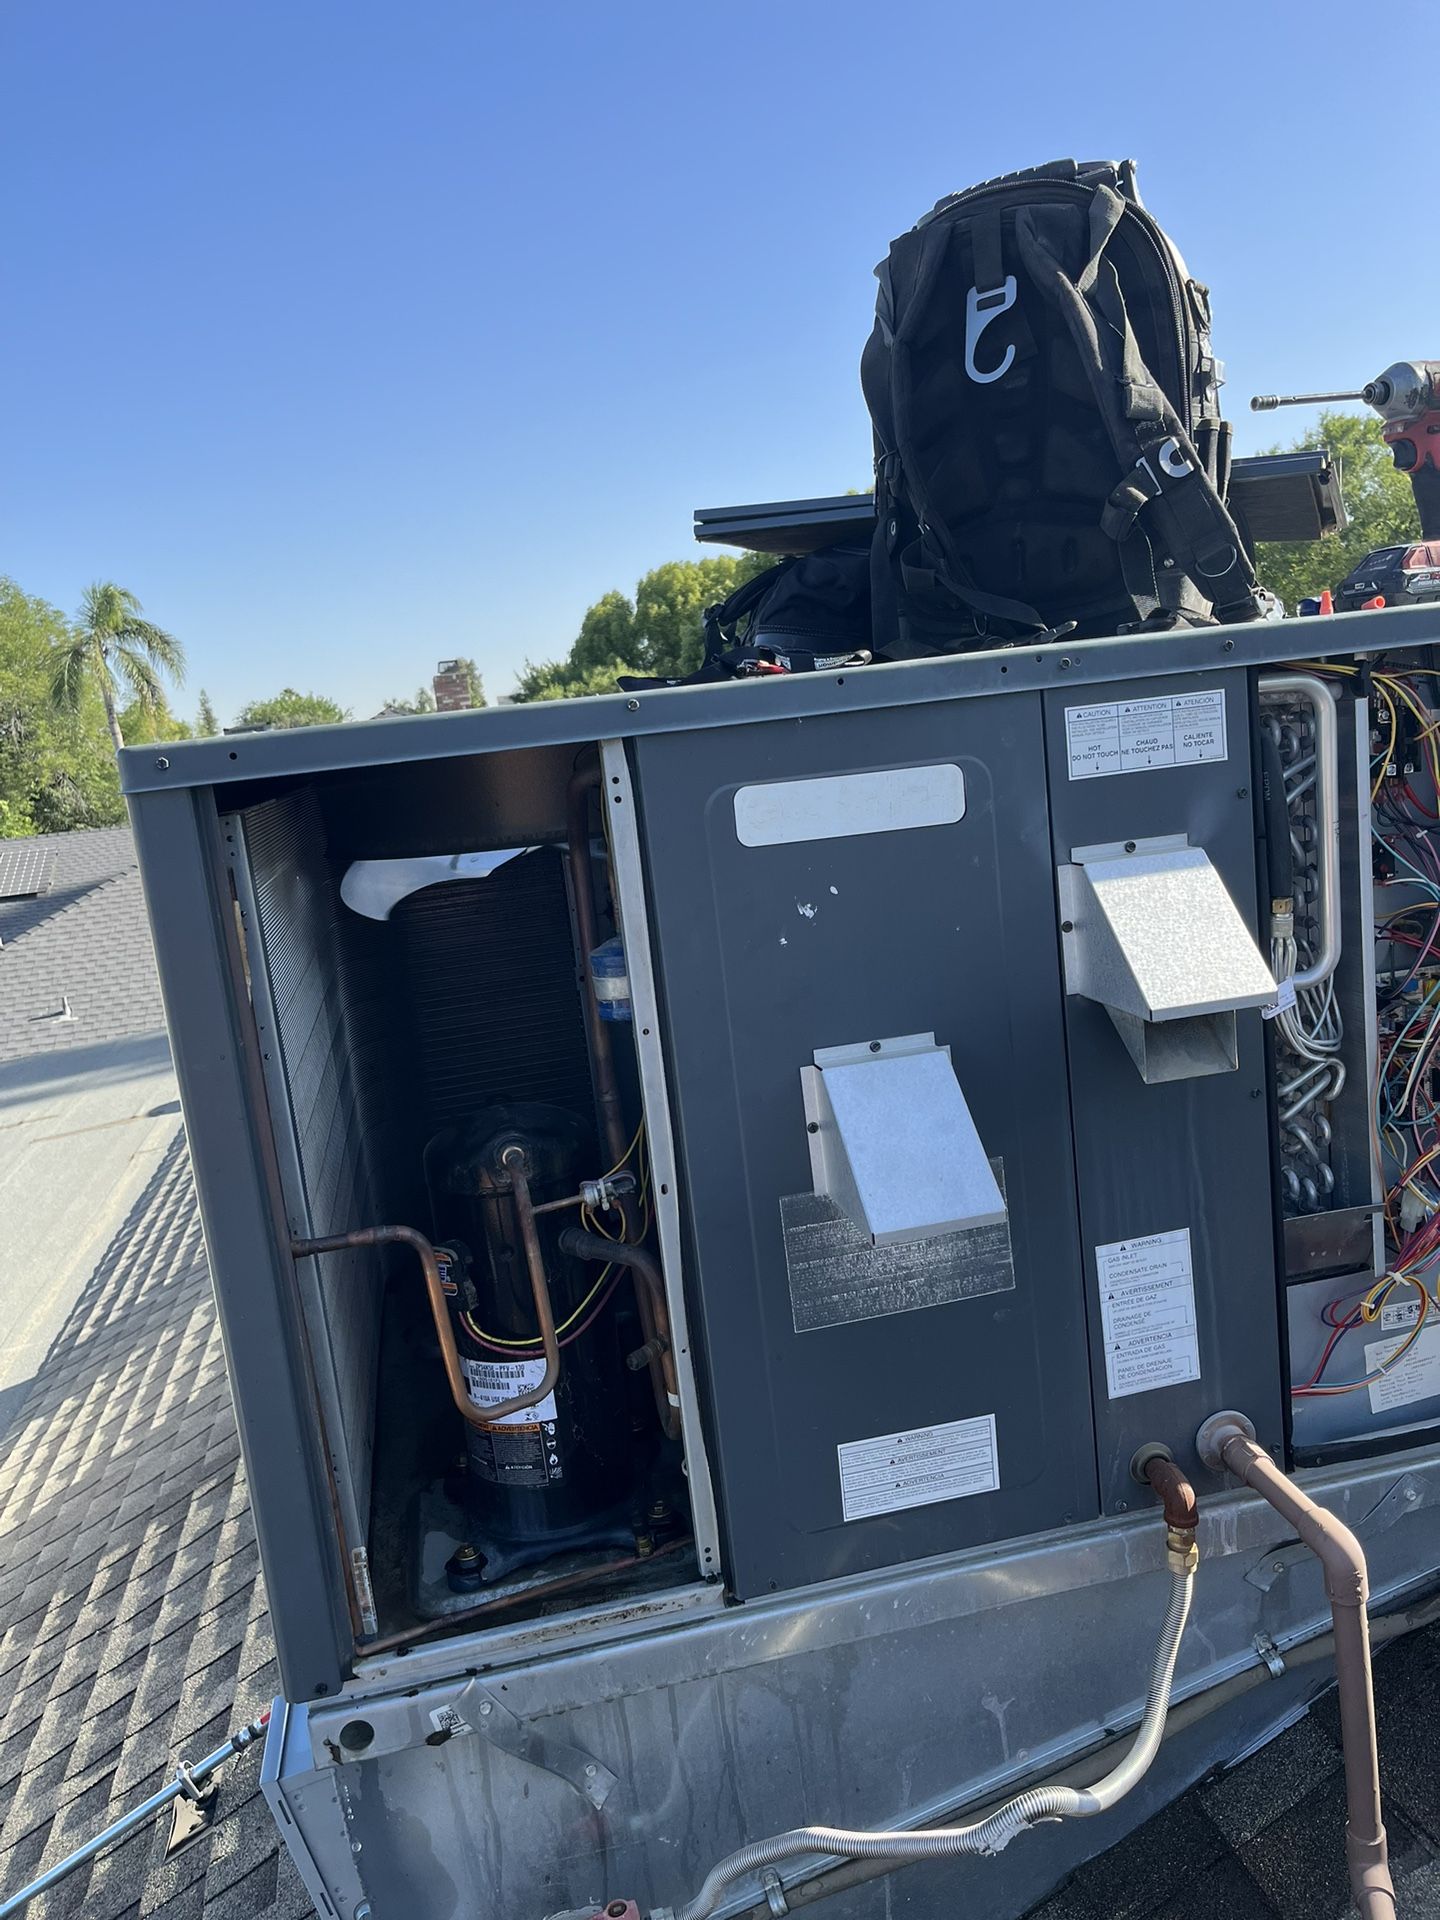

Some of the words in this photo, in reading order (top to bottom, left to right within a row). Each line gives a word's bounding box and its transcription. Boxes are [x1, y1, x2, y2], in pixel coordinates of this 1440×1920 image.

[1132, 703, 1167, 712] ATTENTION
[1083, 709, 1111, 718] CAUTION
[1136, 738, 1158, 746] CHAUD
[1183, 732, 1213, 741] CALIENTE
[1183, 740, 1193, 748] NO
[1194, 738, 1214, 746] TOCAR
[1131, 745, 1160, 755] TOUCHEZ
[1161, 743, 1173, 751] PAS
[1082, 752, 1095, 760] NOT
[1097, 750, 1119, 759] TOUCH
[1131, 1237, 1162, 1249] WARNING
[1108, 1255, 1120, 1264] GAS
[1122, 1253, 1138, 1262] INLET
[1109, 1267, 1148, 1279] CONDENSATE
[1121, 1281, 1173, 1297] AVERTISSEMENT
[1146, 1293, 1157, 1302] GAZ
[1128, 1332, 1172, 1347] ADVERTENCIA
[1116, 1349, 1143, 1359] ENTRADA
[1154, 1343, 1166, 1352] GAS
[1118, 1364, 1136, 1374] PANEL
[1118, 1372, 1126, 1380] DE
[905, 1431, 933, 1442] WARNING
[898, 1449, 946, 1464] AVERTISSEMENT
[903, 1473, 944, 1487] ADVERTENCIA
